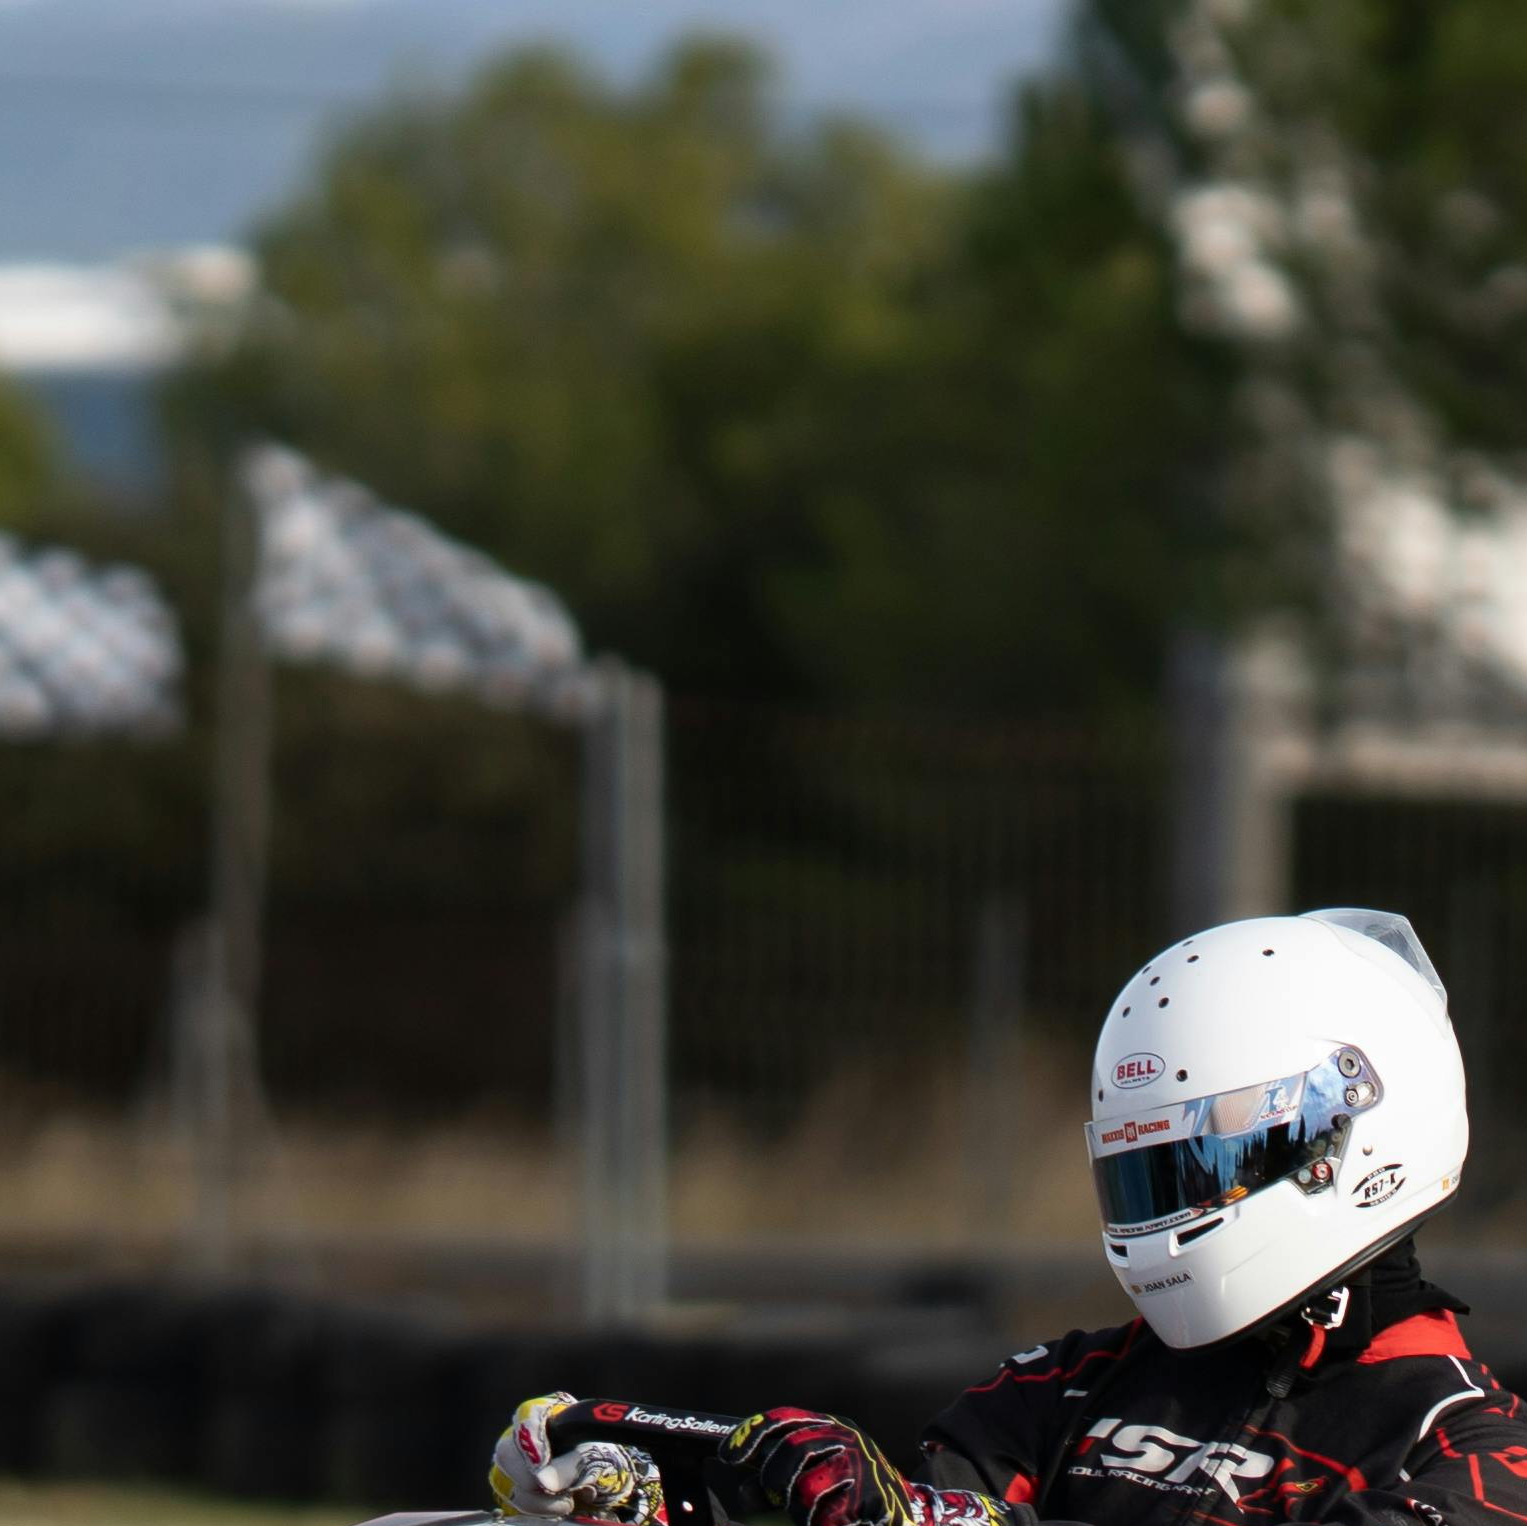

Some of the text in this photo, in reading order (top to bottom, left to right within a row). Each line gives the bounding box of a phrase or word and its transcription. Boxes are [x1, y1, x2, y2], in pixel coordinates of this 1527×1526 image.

[1117, 1060, 1156, 1080] BELL
[1166, 1273, 1192, 1287] SALA
[1108, 1469, 1171, 1491] RACING
